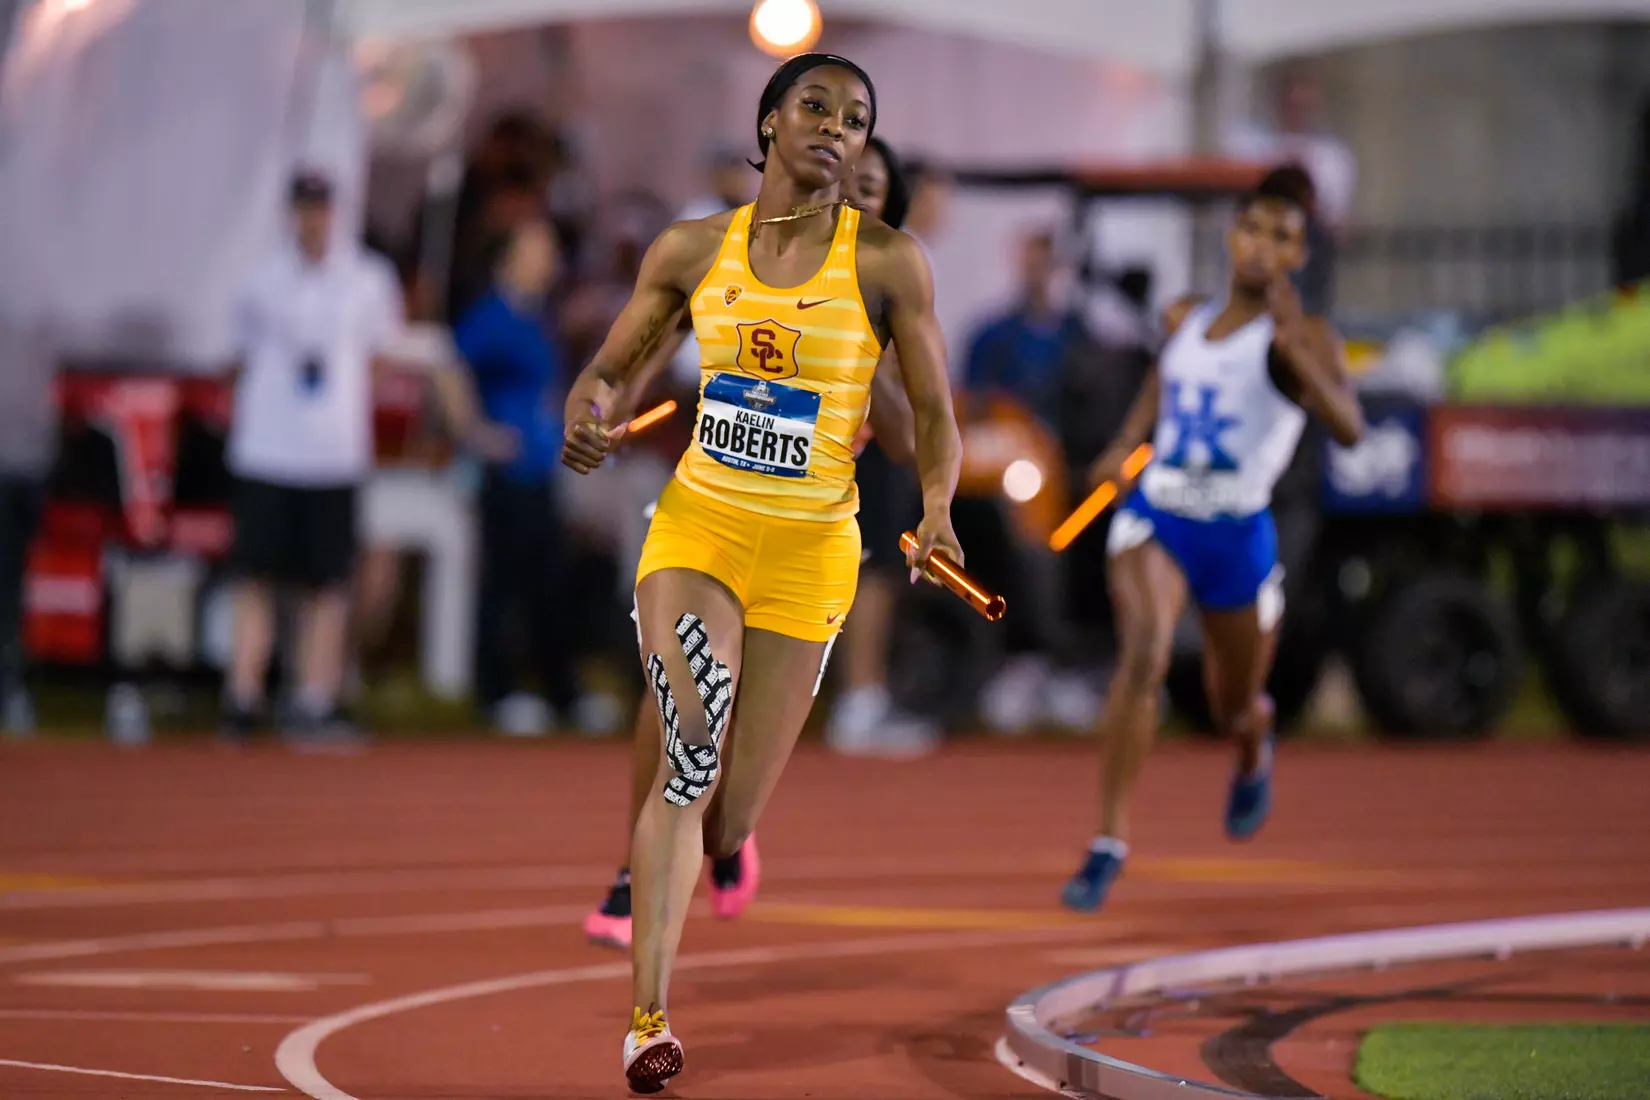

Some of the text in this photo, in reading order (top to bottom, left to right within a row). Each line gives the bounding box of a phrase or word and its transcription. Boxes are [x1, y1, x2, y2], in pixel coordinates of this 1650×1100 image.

[751, 328, 783, 373] SC
[699, 413, 809, 467] ROBERTS
[735, 410, 775, 430] KAELIN
